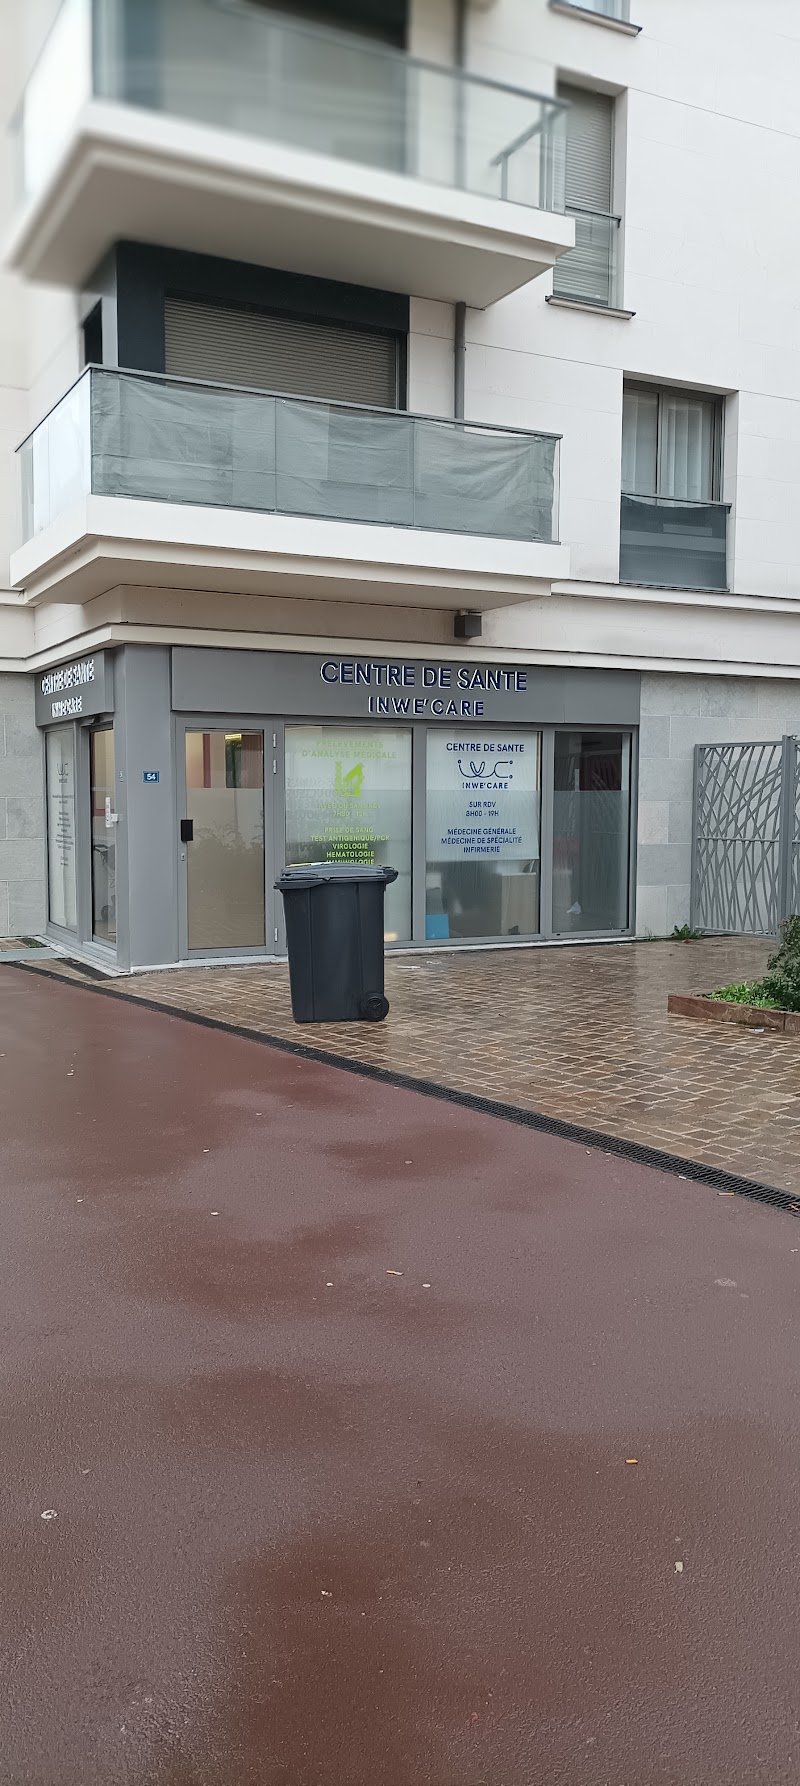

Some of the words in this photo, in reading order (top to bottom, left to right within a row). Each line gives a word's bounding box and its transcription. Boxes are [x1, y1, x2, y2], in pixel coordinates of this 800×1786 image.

[320, 660, 415, 688] CENTRE
[422, 666, 451, 689] DE
[457, 668, 527, 692] SANTE
[368, 696, 484, 717] INWE'CARE
[446, 742, 481, 752] CENTRE
[483, 743, 495, 752] DE
[497, 744, 525, 753] SANTE
[447, 827, 481, 835] MÉDECINE
[483, 827, 517, 835] GÉNÉRALE
[441, 836, 475, 844] MÉDECINE
